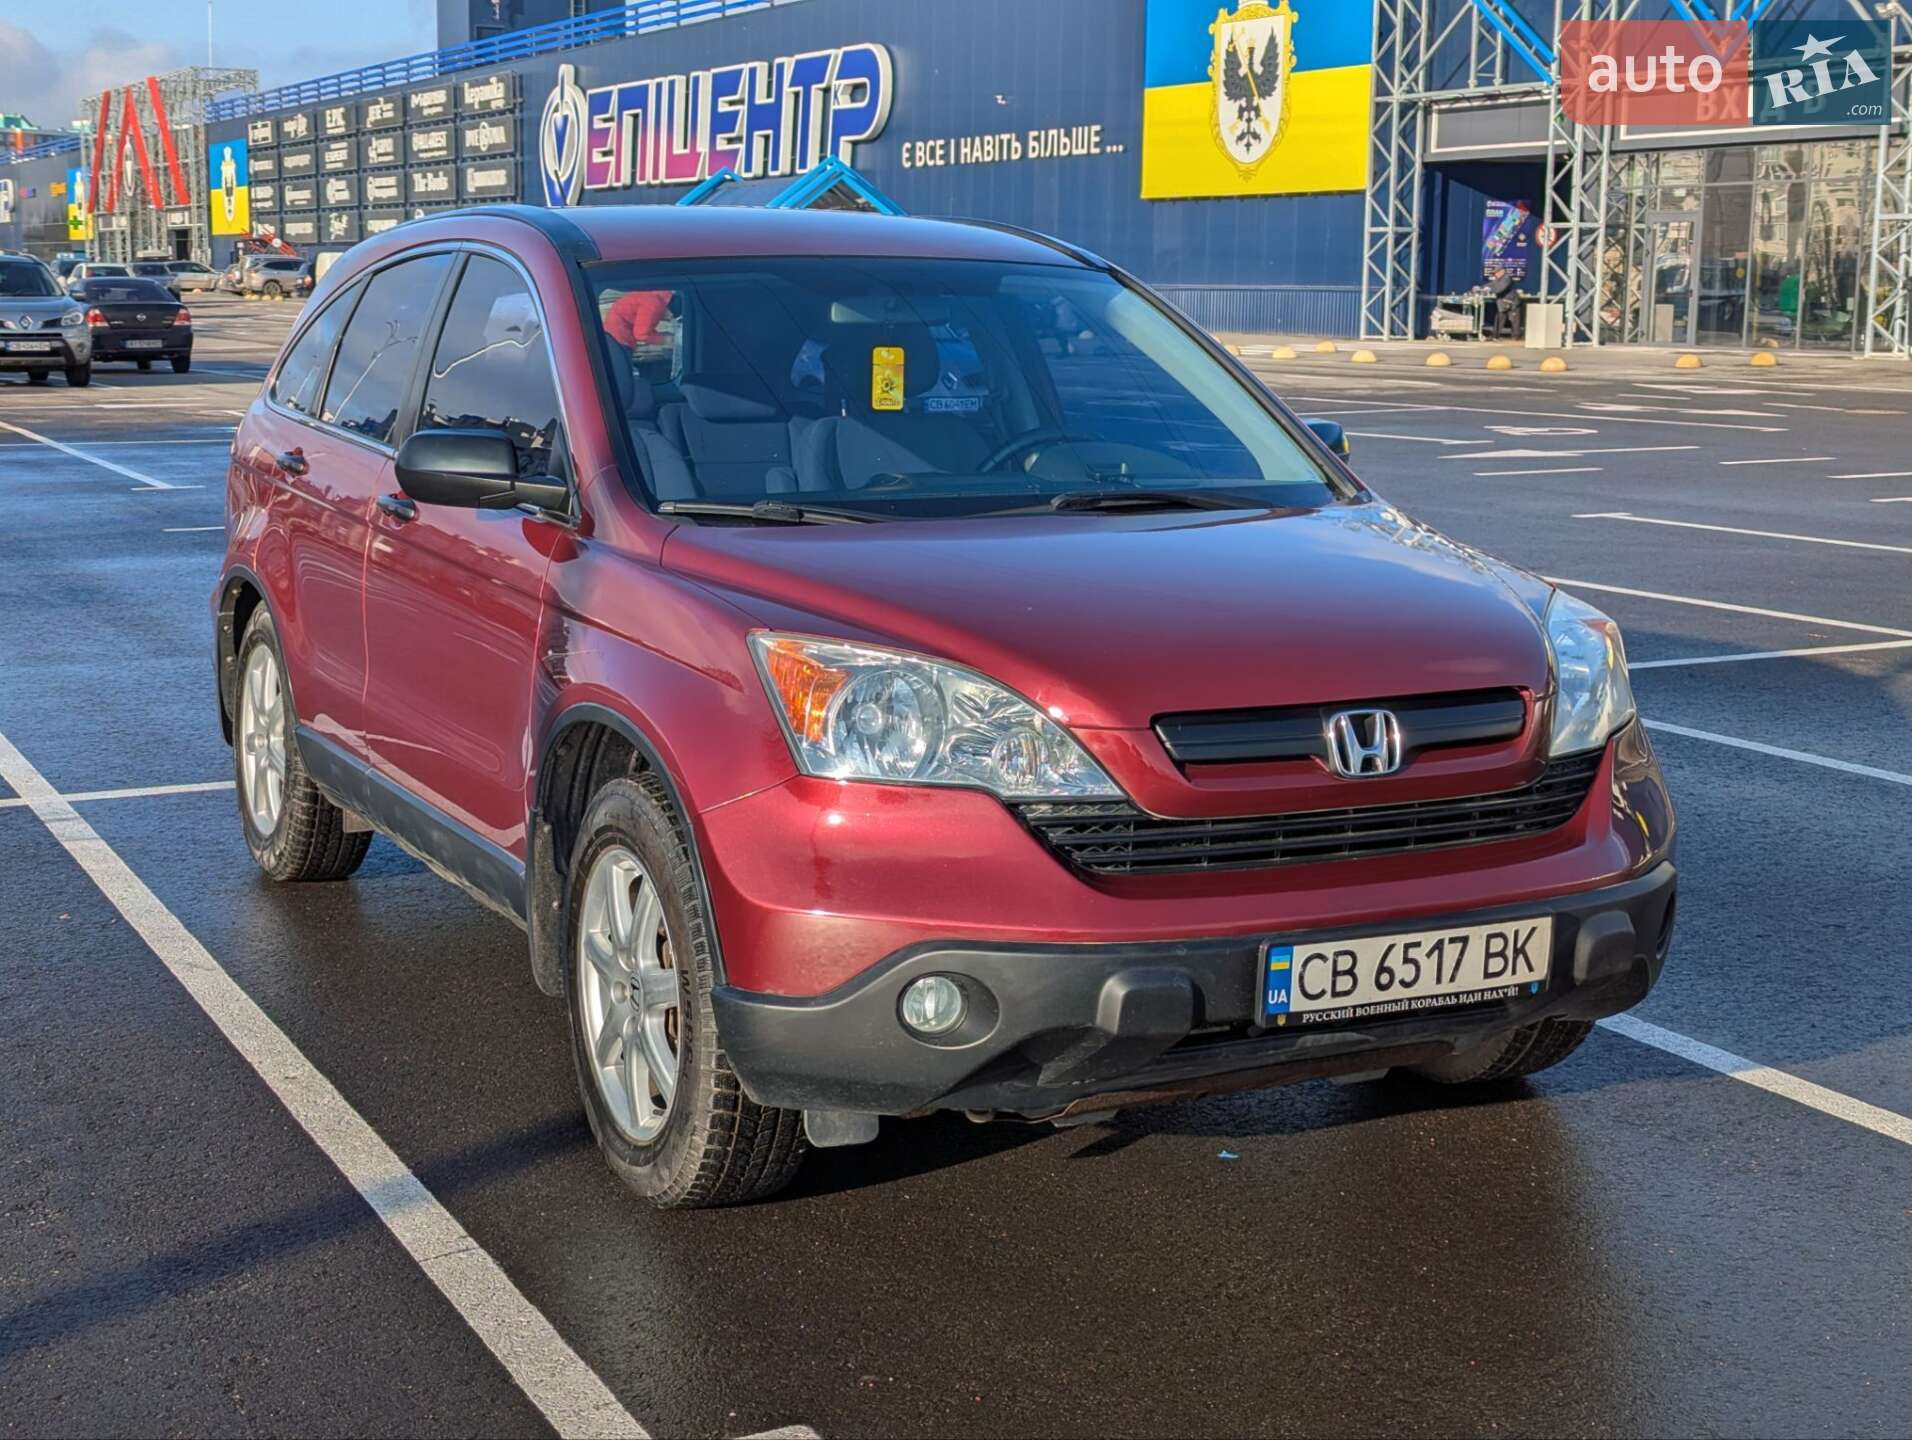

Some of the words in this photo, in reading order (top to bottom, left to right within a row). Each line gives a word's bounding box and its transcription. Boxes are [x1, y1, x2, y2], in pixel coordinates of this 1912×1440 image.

[585, 43, 892, 190] ЕПІЦЕНТР
[902, 142, 912, 168] Є
[915, 138, 945, 167] ВСЕ
[960, 133, 1022, 164] НАВІТЬ
[1028, 125, 1102, 158] БІЛЬШЕ
[1298, 950, 1358, 1001] CB
[1374, 936, 1470, 992] 6517
[1483, 926, 1538, 980] BK
[1268, 989, 1288, 1005] UA
[1302, 1007, 1354, 1023] РУССКИЙ
[1355, 1001, 1409, 1018] ВОЕННЫЙ
[1411, 995, 1458, 1010] КОРАБЛЬ
[1459, 992, 1482, 1004] ИДИ
